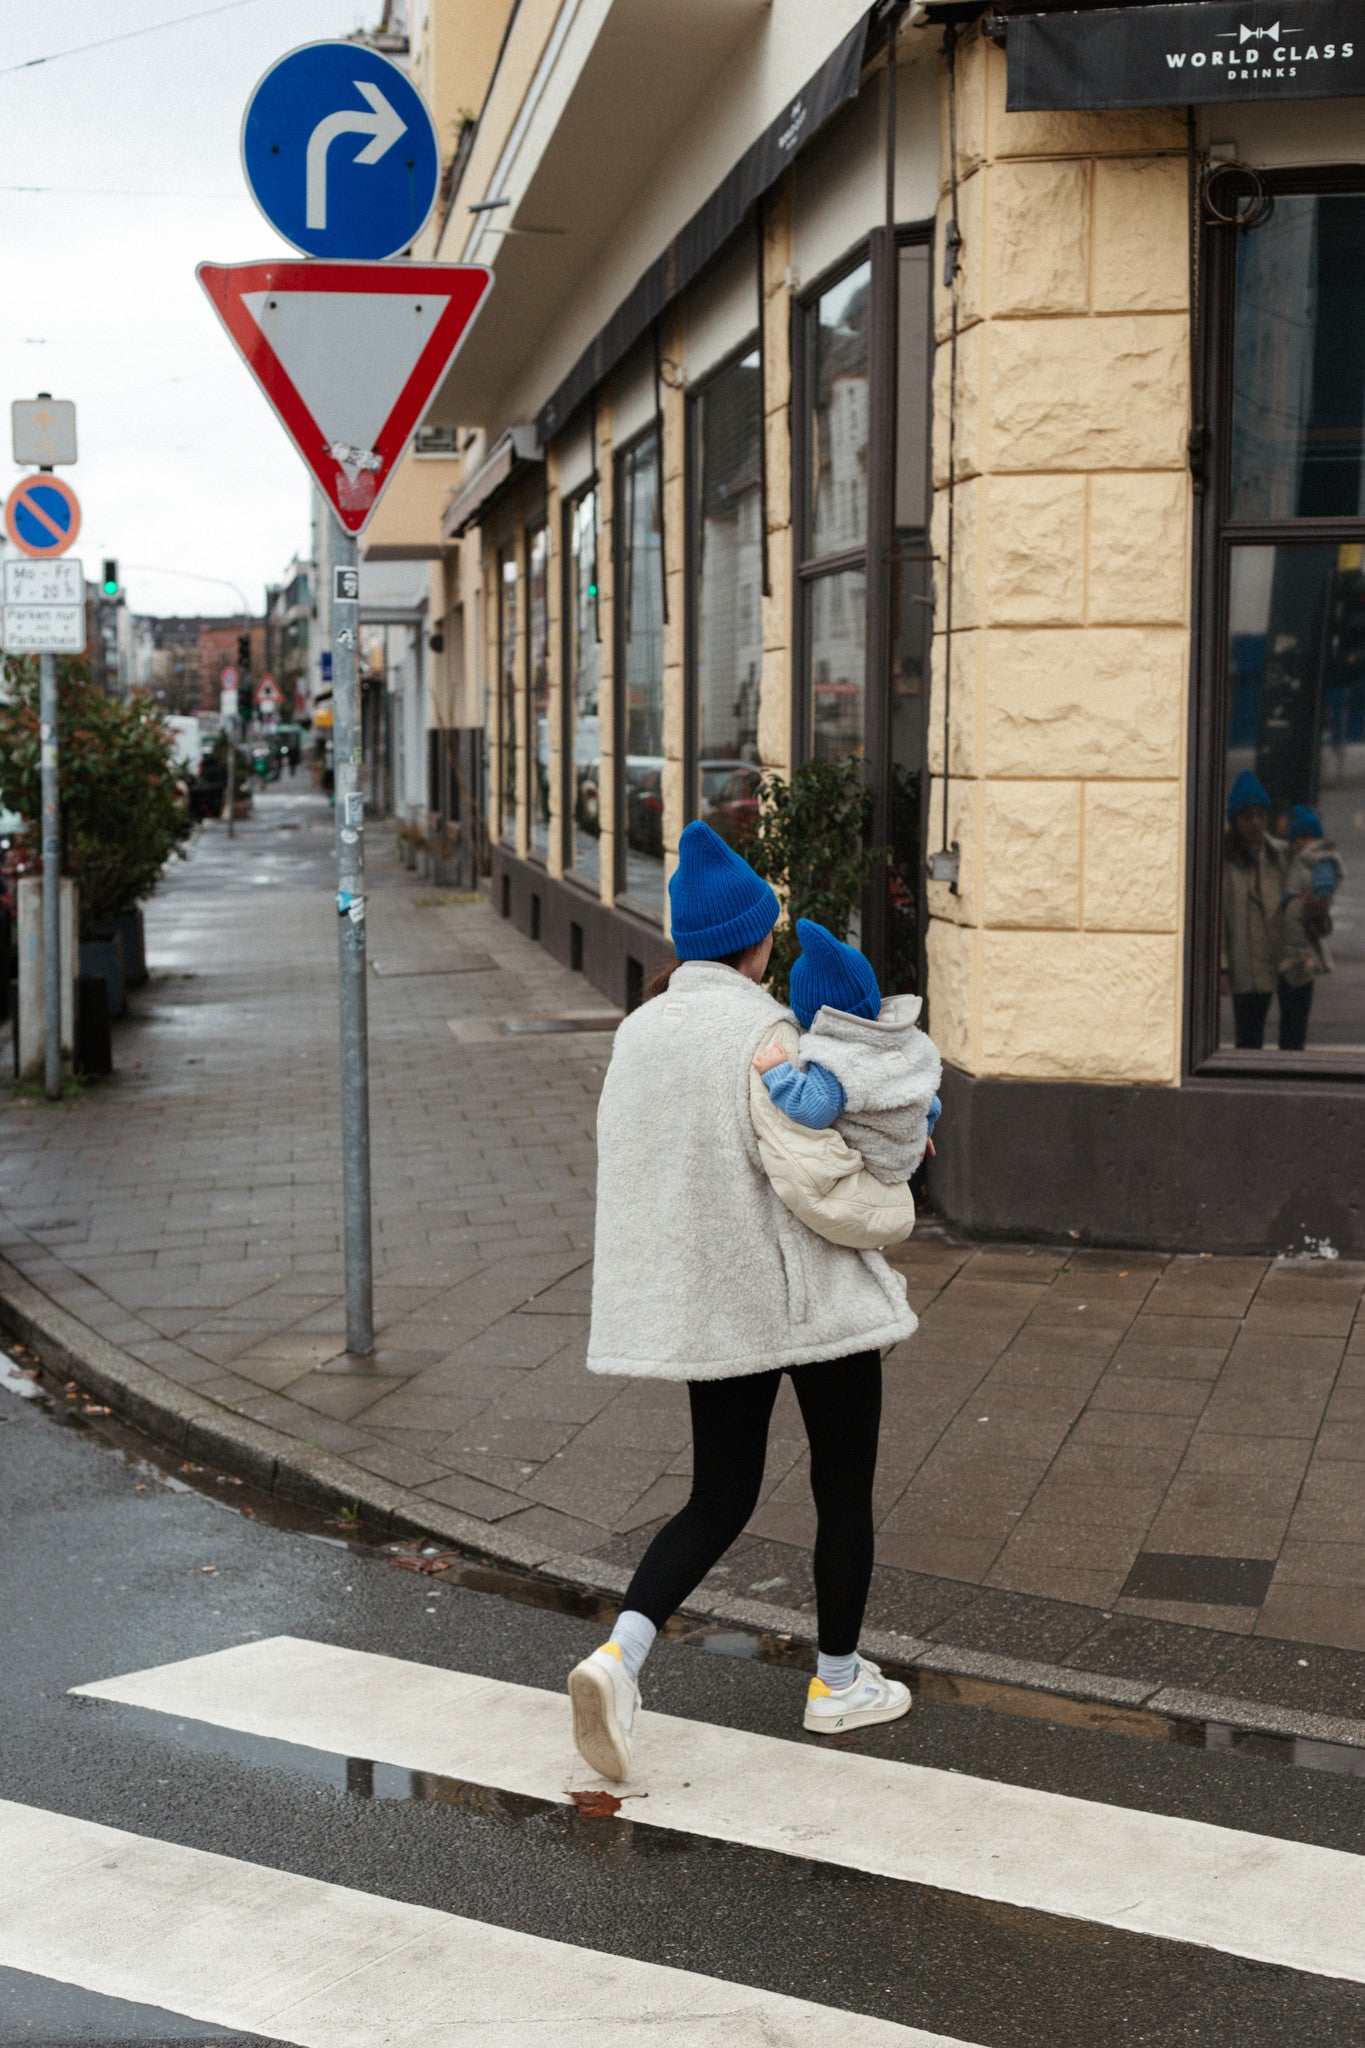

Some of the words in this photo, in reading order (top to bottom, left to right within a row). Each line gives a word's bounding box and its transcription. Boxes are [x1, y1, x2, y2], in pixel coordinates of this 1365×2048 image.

[1165, 49, 1259, 69] WORLD
[1273, 42, 1354, 62] CLASS
[1227, 67, 1297, 80] DRINKS
